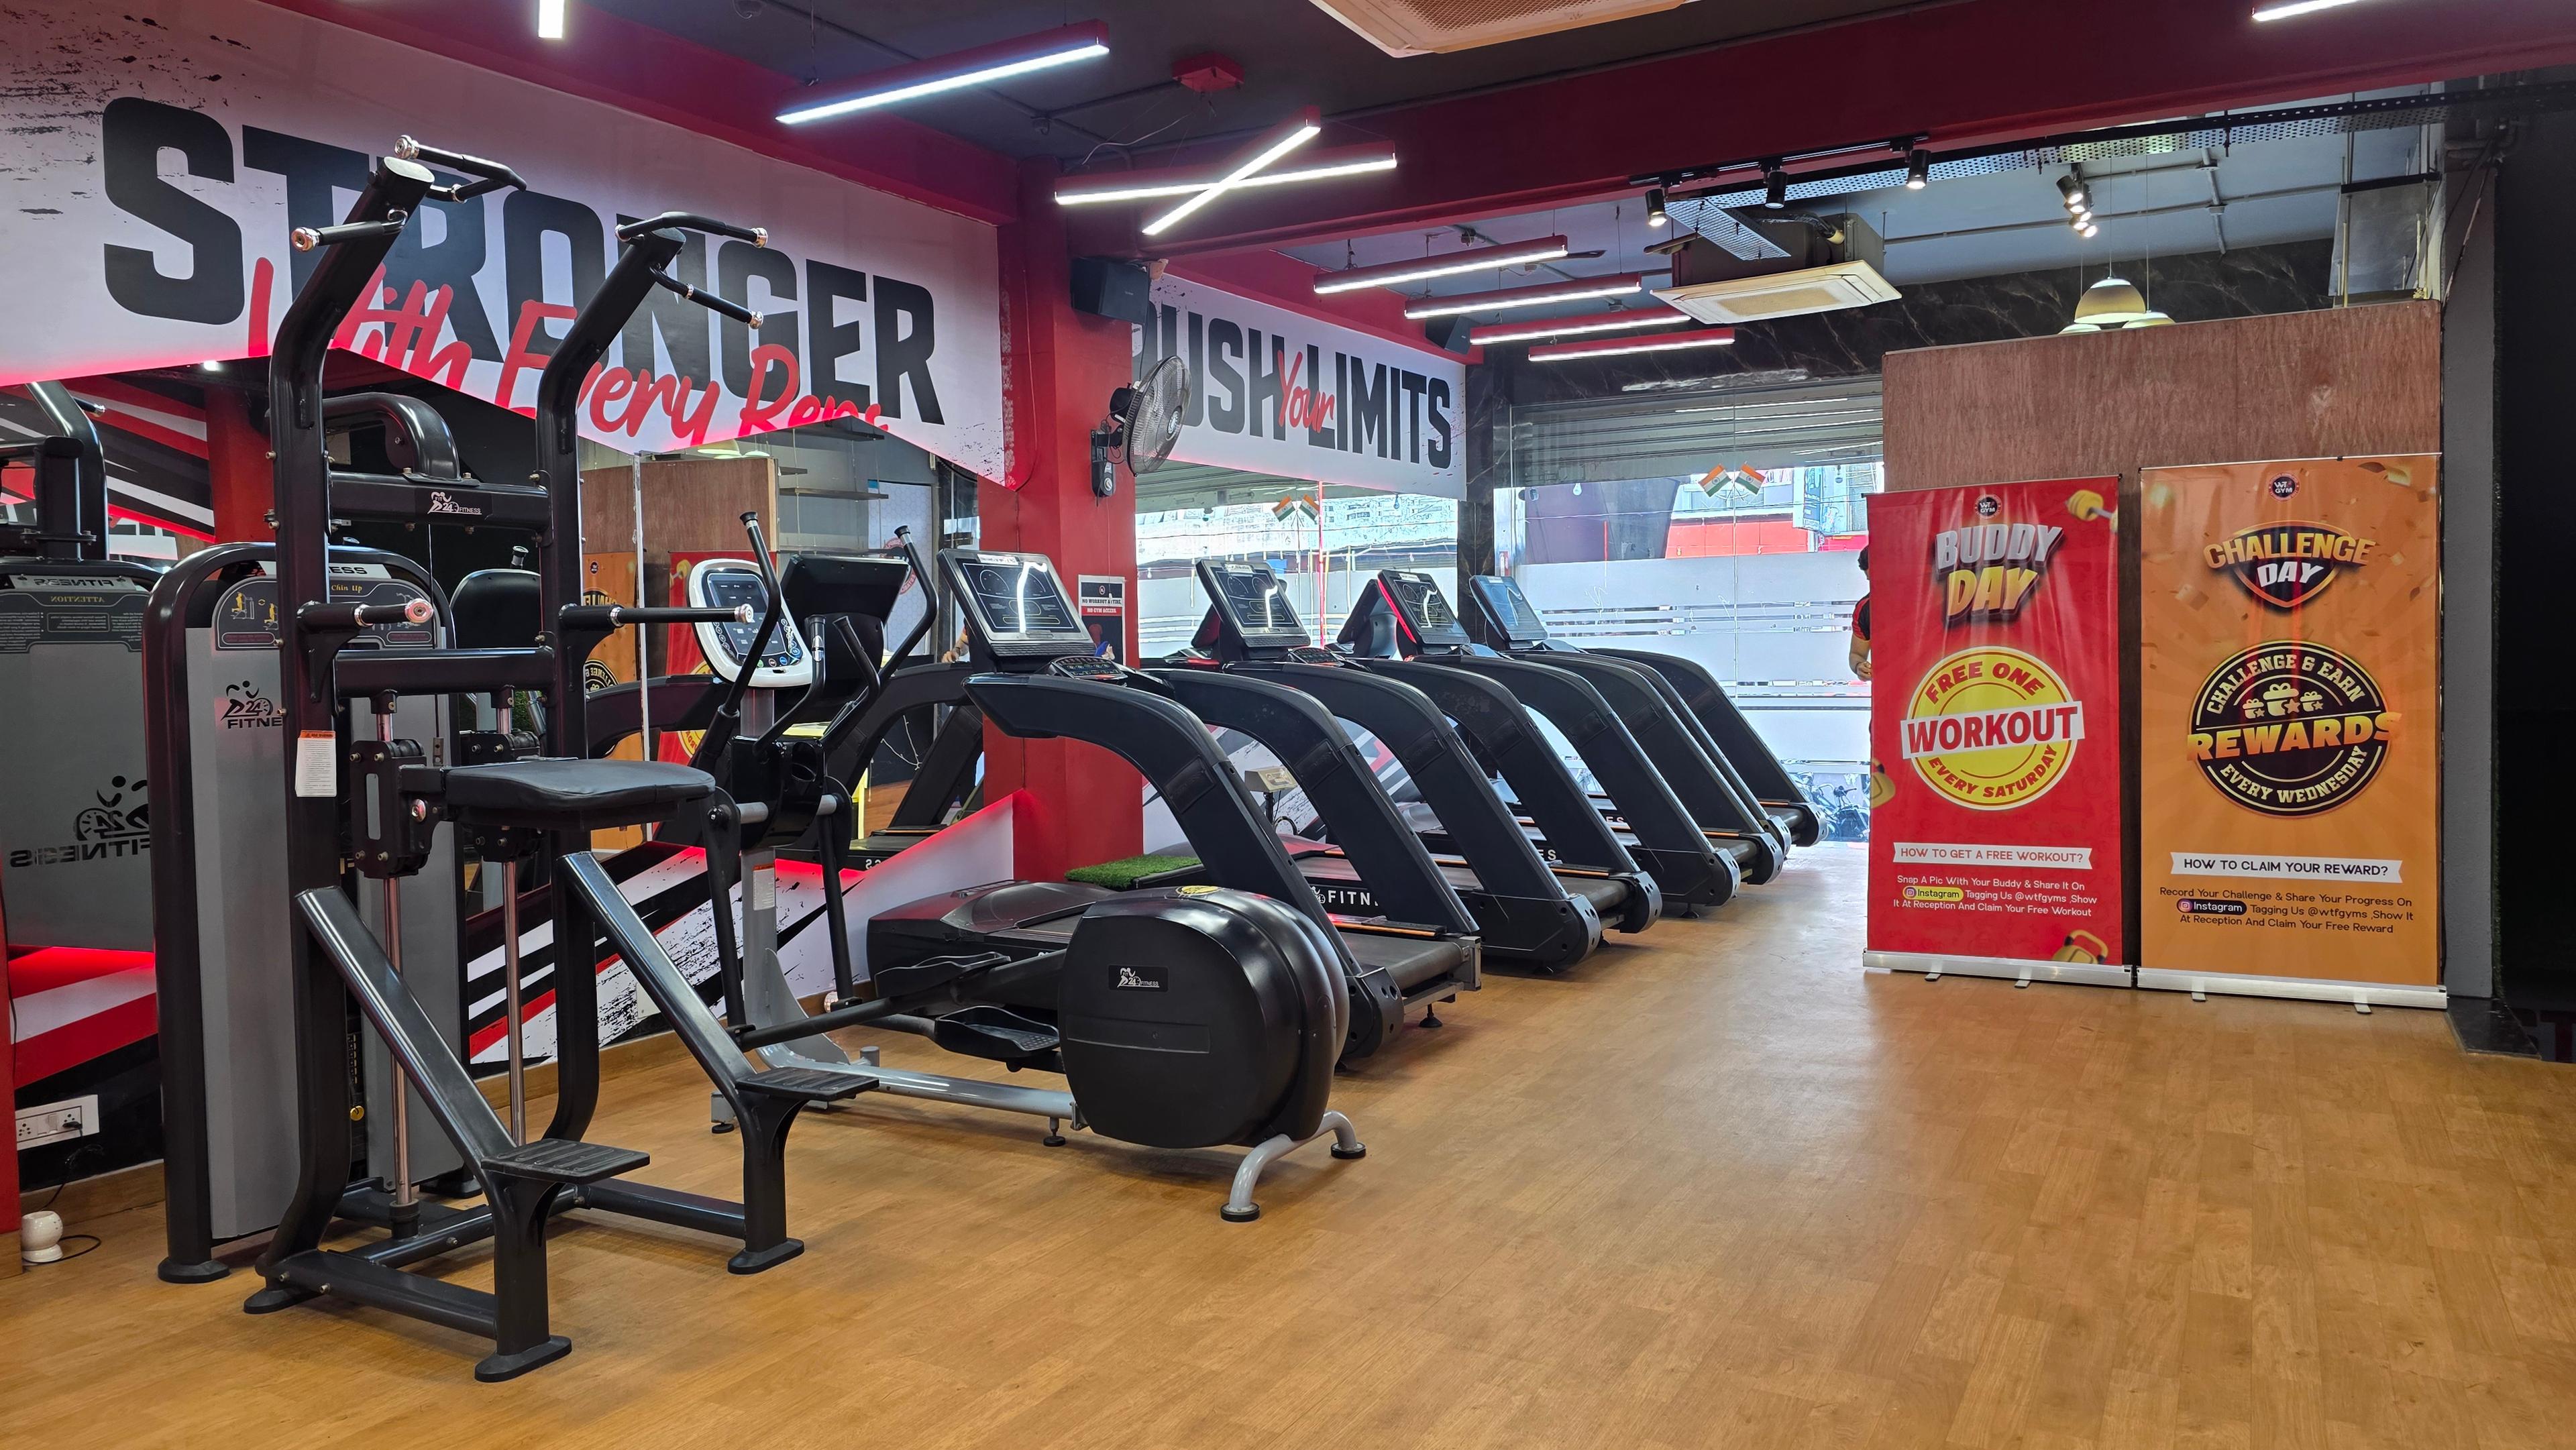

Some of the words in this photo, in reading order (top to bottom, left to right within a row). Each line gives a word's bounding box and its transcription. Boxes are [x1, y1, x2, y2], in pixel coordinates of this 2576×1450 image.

[102, 97, 945, 425] STRONGER
[1277, 349, 1334, 434] Your
[1307, 343, 1452, 469] LIMITS
[1935, 523, 2063, 571] BUDDY
[2203, 533, 2377, 569] CHALLENGE
[352, 585, 363, 593] Up
[1947, 566, 2039, 616] DAY
[2257, 561, 2324, 588] DAY
[1925, 661, 1983, 705] FREE
[1992, 663, 2046, 696] ONE
[2206, 654, 2298, 715] CHALLENGE
[2317, 661, 2366, 702] EARN
[1907, 706, 2078, 754] WORKOUT
[2186, 712, 2403, 761] REWARDS
[1927, 757, 1979, 795] EVERY
[1982, 744, 2057, 798] SATURDAY
[2220, 763, 2273, 801] EVERY
[2276, 745, 2368, 803] WEDNESDAY
[1900, 848, 1928, 858] HOW
[1932, 848, 1947, 858] TO
[1950, 849, 1972, 859] GET
[1976, 850, 1983, 859] A
[1986, 850, 2012, 860] FREE
[2017, 851, 2083, 862] WORKOUT?
[2184, 858, 2215, 869] HOW
[2220, 860, 2237, 870] TO
[2241, 860, 2281, 871] CLAIM
[2285, 862, 2320, 873] YOUR
[2324, 863, 2388, 876] REWARD?
[1897, 875, 1919, 885] Snap
[1921, 876, 1927, 884] A
[1929, 876, 1943, 885] Pic
[1945, 877, 1968, 886] With
[1971, 877, 1990, 887] Your
[1993, 878, 2022, 889] Buddy
[2024, 880, 2031, 888] &
[2033, 881, 2060, 889] Share
[2063, 882, 2069, 890] It
[2072, 882, 2085, 891] On
[1917, 889, 1960, 899] Instagram
[1965, 890, 1998, 901] Tagging
[2000, 891, 2012, 900] Us
[2015, 891, 2067, 903] @wtfgyms
[2160, 887, 2194, 897] Record
[2198, 888, 2219, 898] Your
[2222, 889, 2272, 901] Challenge
[2275, 892, 2283, 901] &
[2286, 893, 2316, 902] Share
[2319, 894, 2342, 903] Your
[2345, 895, 2394, 906] Progress
[2397, 897, 2412, 907] On
[1893, 899, 1900, 907] It
[1902, 900, 1911, 908] At
[1913, 901, 1955, 910] Reception
[1958, 902, 1975, 910] And
[1978, 903, 2002, 912] Claim
[2004, 903, 2025, 912] Your
[2027, 905, 2049, 914] Free
[2051, 906, 2092, 916] Workout
[2180, 915, 2190, 923] At
[2194, 915, 2243, 926] Reception
[2245, 917, 2265, 926] And
[2267, 918, 2296, 928] Claim
[2300, 919, 2322, 929] Your
[2326, 922, 2349, 930] Free
[2353, 923, 2394, 933] Reward
[2194, 901, 2243, 913] Instagram
[2250, 904, 2288, 916] Tagging
[2291, 907, 2304, 915] Us
[2308, 907, 2367, 919] @wtfgyms
[2406, 911, 2414, 921] It
